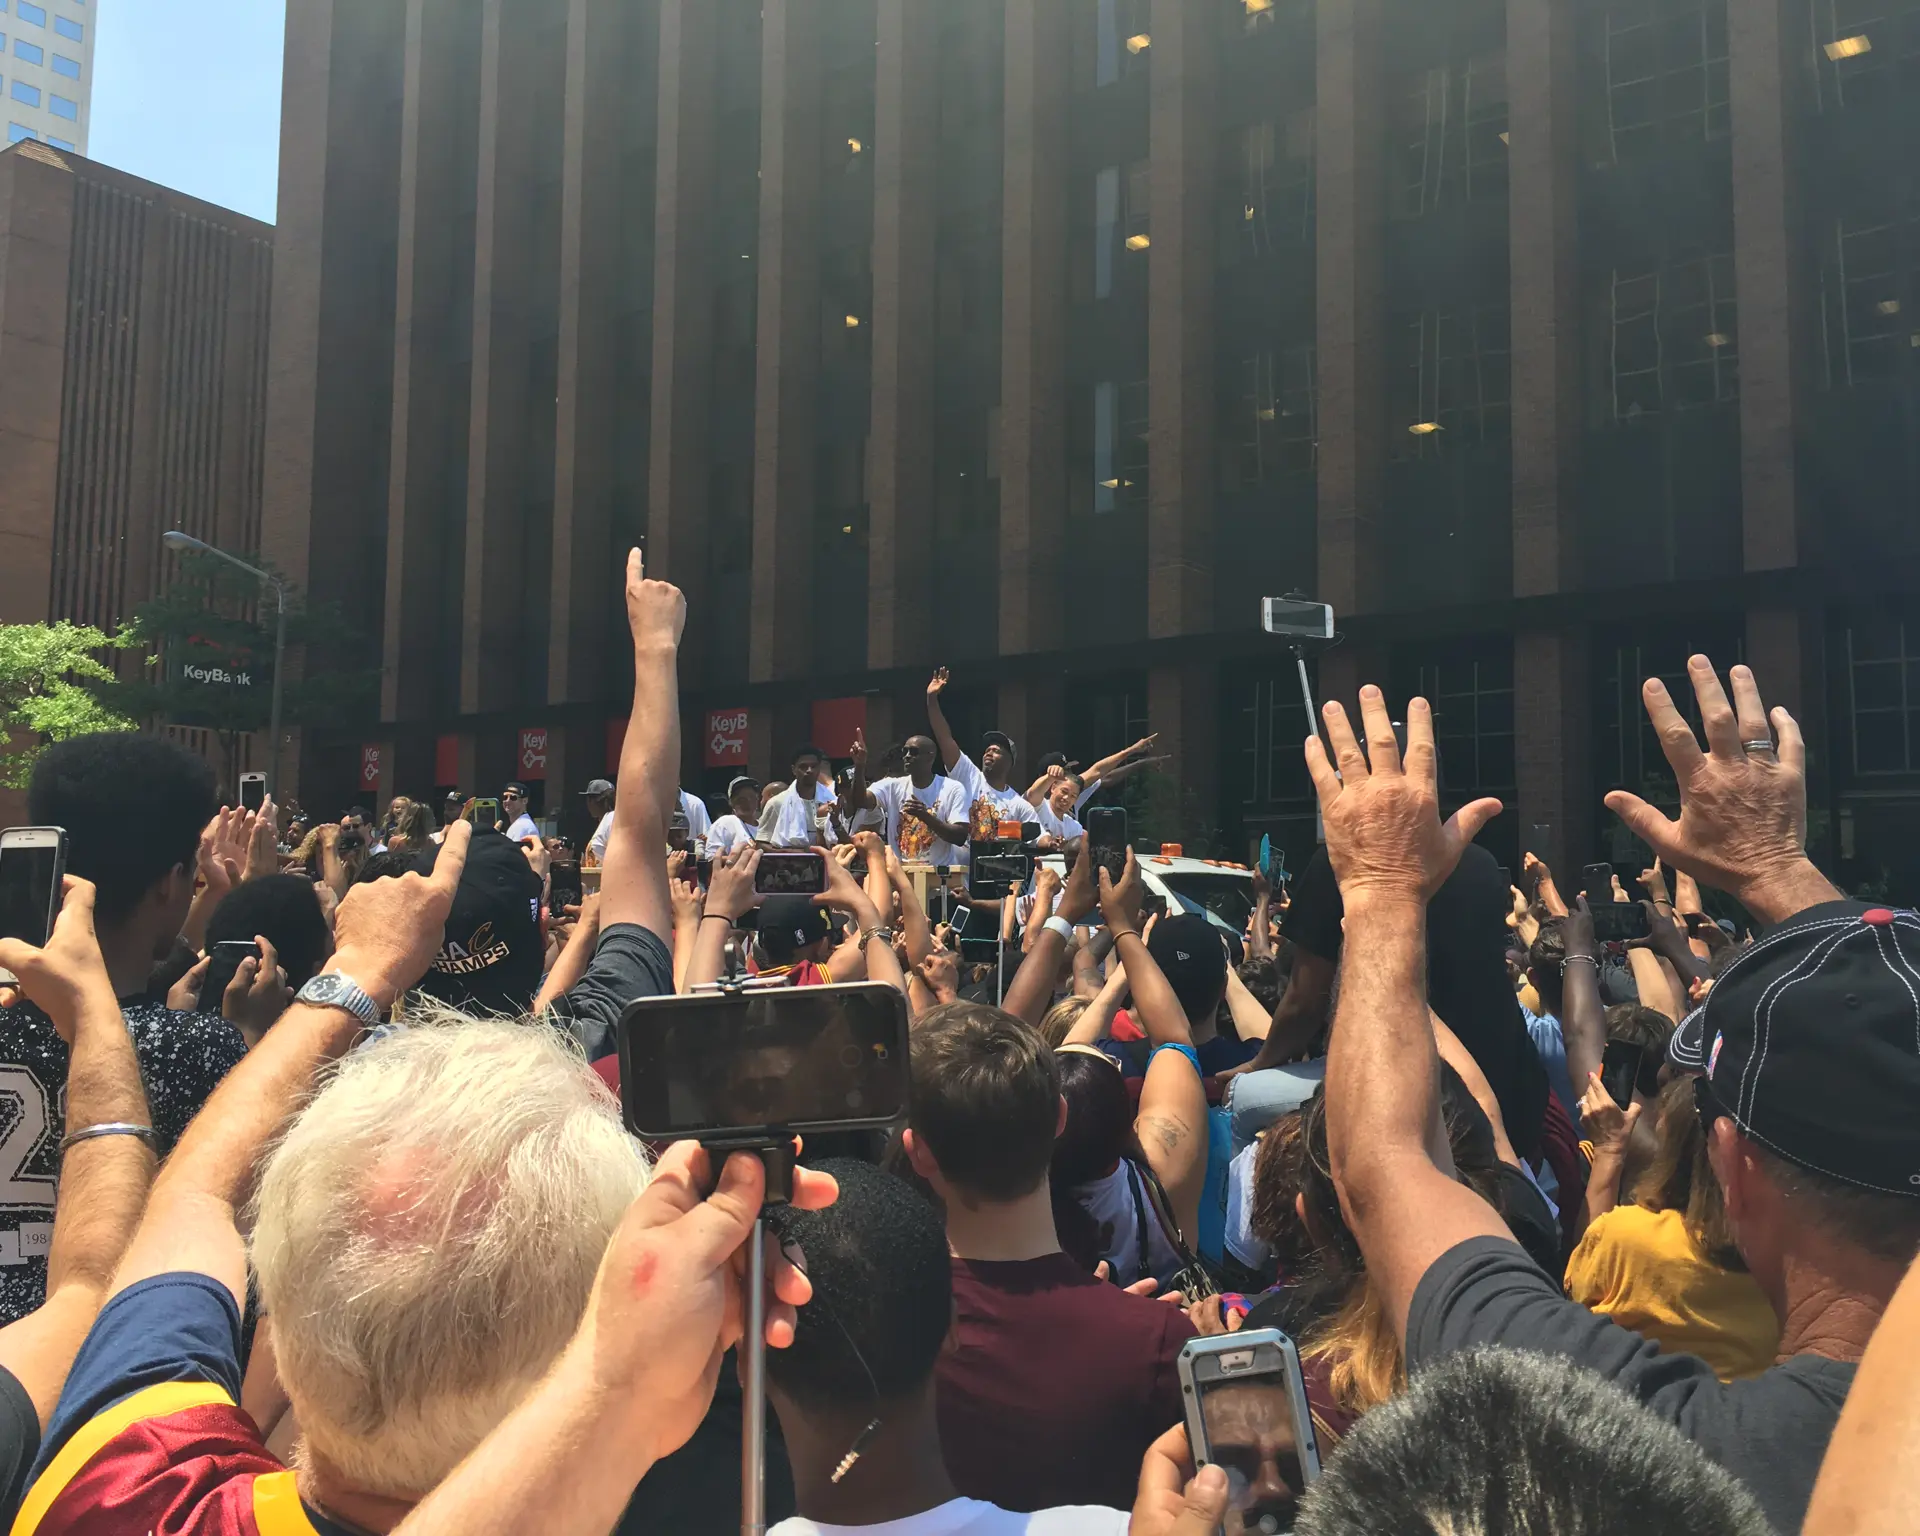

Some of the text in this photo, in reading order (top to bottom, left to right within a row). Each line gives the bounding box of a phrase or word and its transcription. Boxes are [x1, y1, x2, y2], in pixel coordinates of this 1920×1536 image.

[711, 713, 748, 734] KeyB
[523, 733, 547, 750] Key
[365, 747, 379, 761] Ke
[0, 1063, 67, 1212] 2
[25, 1233, 50, 1245] 198
